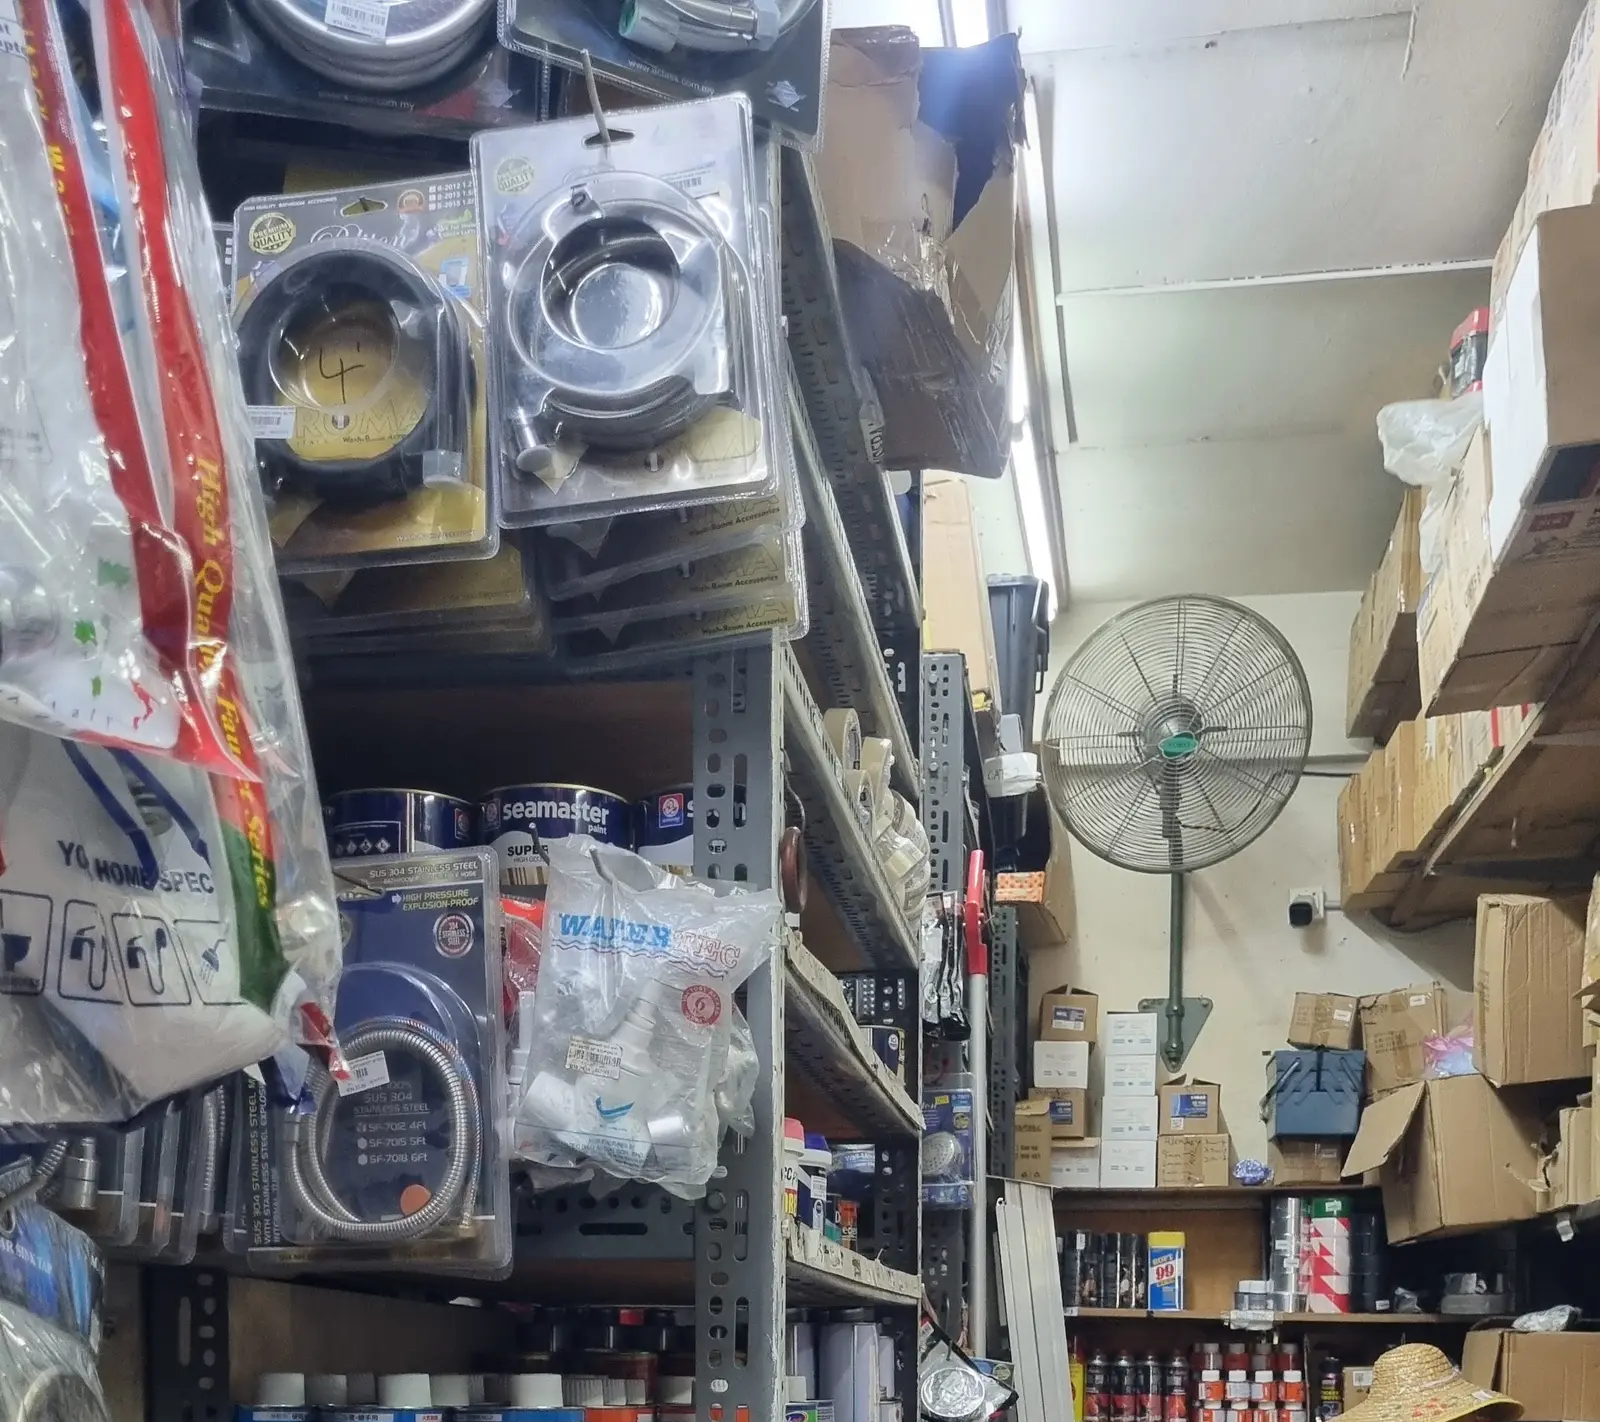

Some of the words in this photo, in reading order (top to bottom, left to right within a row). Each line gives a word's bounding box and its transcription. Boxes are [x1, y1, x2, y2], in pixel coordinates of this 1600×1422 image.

[252, 228, 293, 250] QUALITY
[253, 222, 290, 239] PREMIUM
[735, 505, 780, 524] Accessories
[734, 574, 779, 588] Accessories
[745, 615, 788, 629] Accessories
[196, 457, 227, 546] High
[246, 811, 271, 910] Series
[502, 799, 610, 826] seamaster
[587, 823, 608, 837] paint
[369, 867, 387, 879] SUS
[389, 867, 405, 877] 304
[407, 863, 451, 875] STAINLESS
[453, 860, 478, 870] STEEL
[159, 869, 215, 895] SPEC
[402, 896, 479, 911] EXPLOSION-PROOF
[403, 891, 422, 902] HIGH
[423, 888, 469, 900] PRESSURE
[362, 1092, 388, 1104] SUS
[391, 1091, 413, 1101] 304
[247, 1092, 258, 1127] STEEL
[353, 1103, 400, 1115] STAINLESS
[402, 1102, 429, 1112] STEEL
[260, 1129, 269, 1160] STEEL
[249, 1130, 261, 1191] STAINLESS
[261, 1162, 271, 1217] STAINLESS
[251, 1194, 261, 1218] 304
[252, 1220, 263, 1245] SUS
[262, 1218, 272, 1245] WITH
[1155, 1263, 1175, 1281] 99
